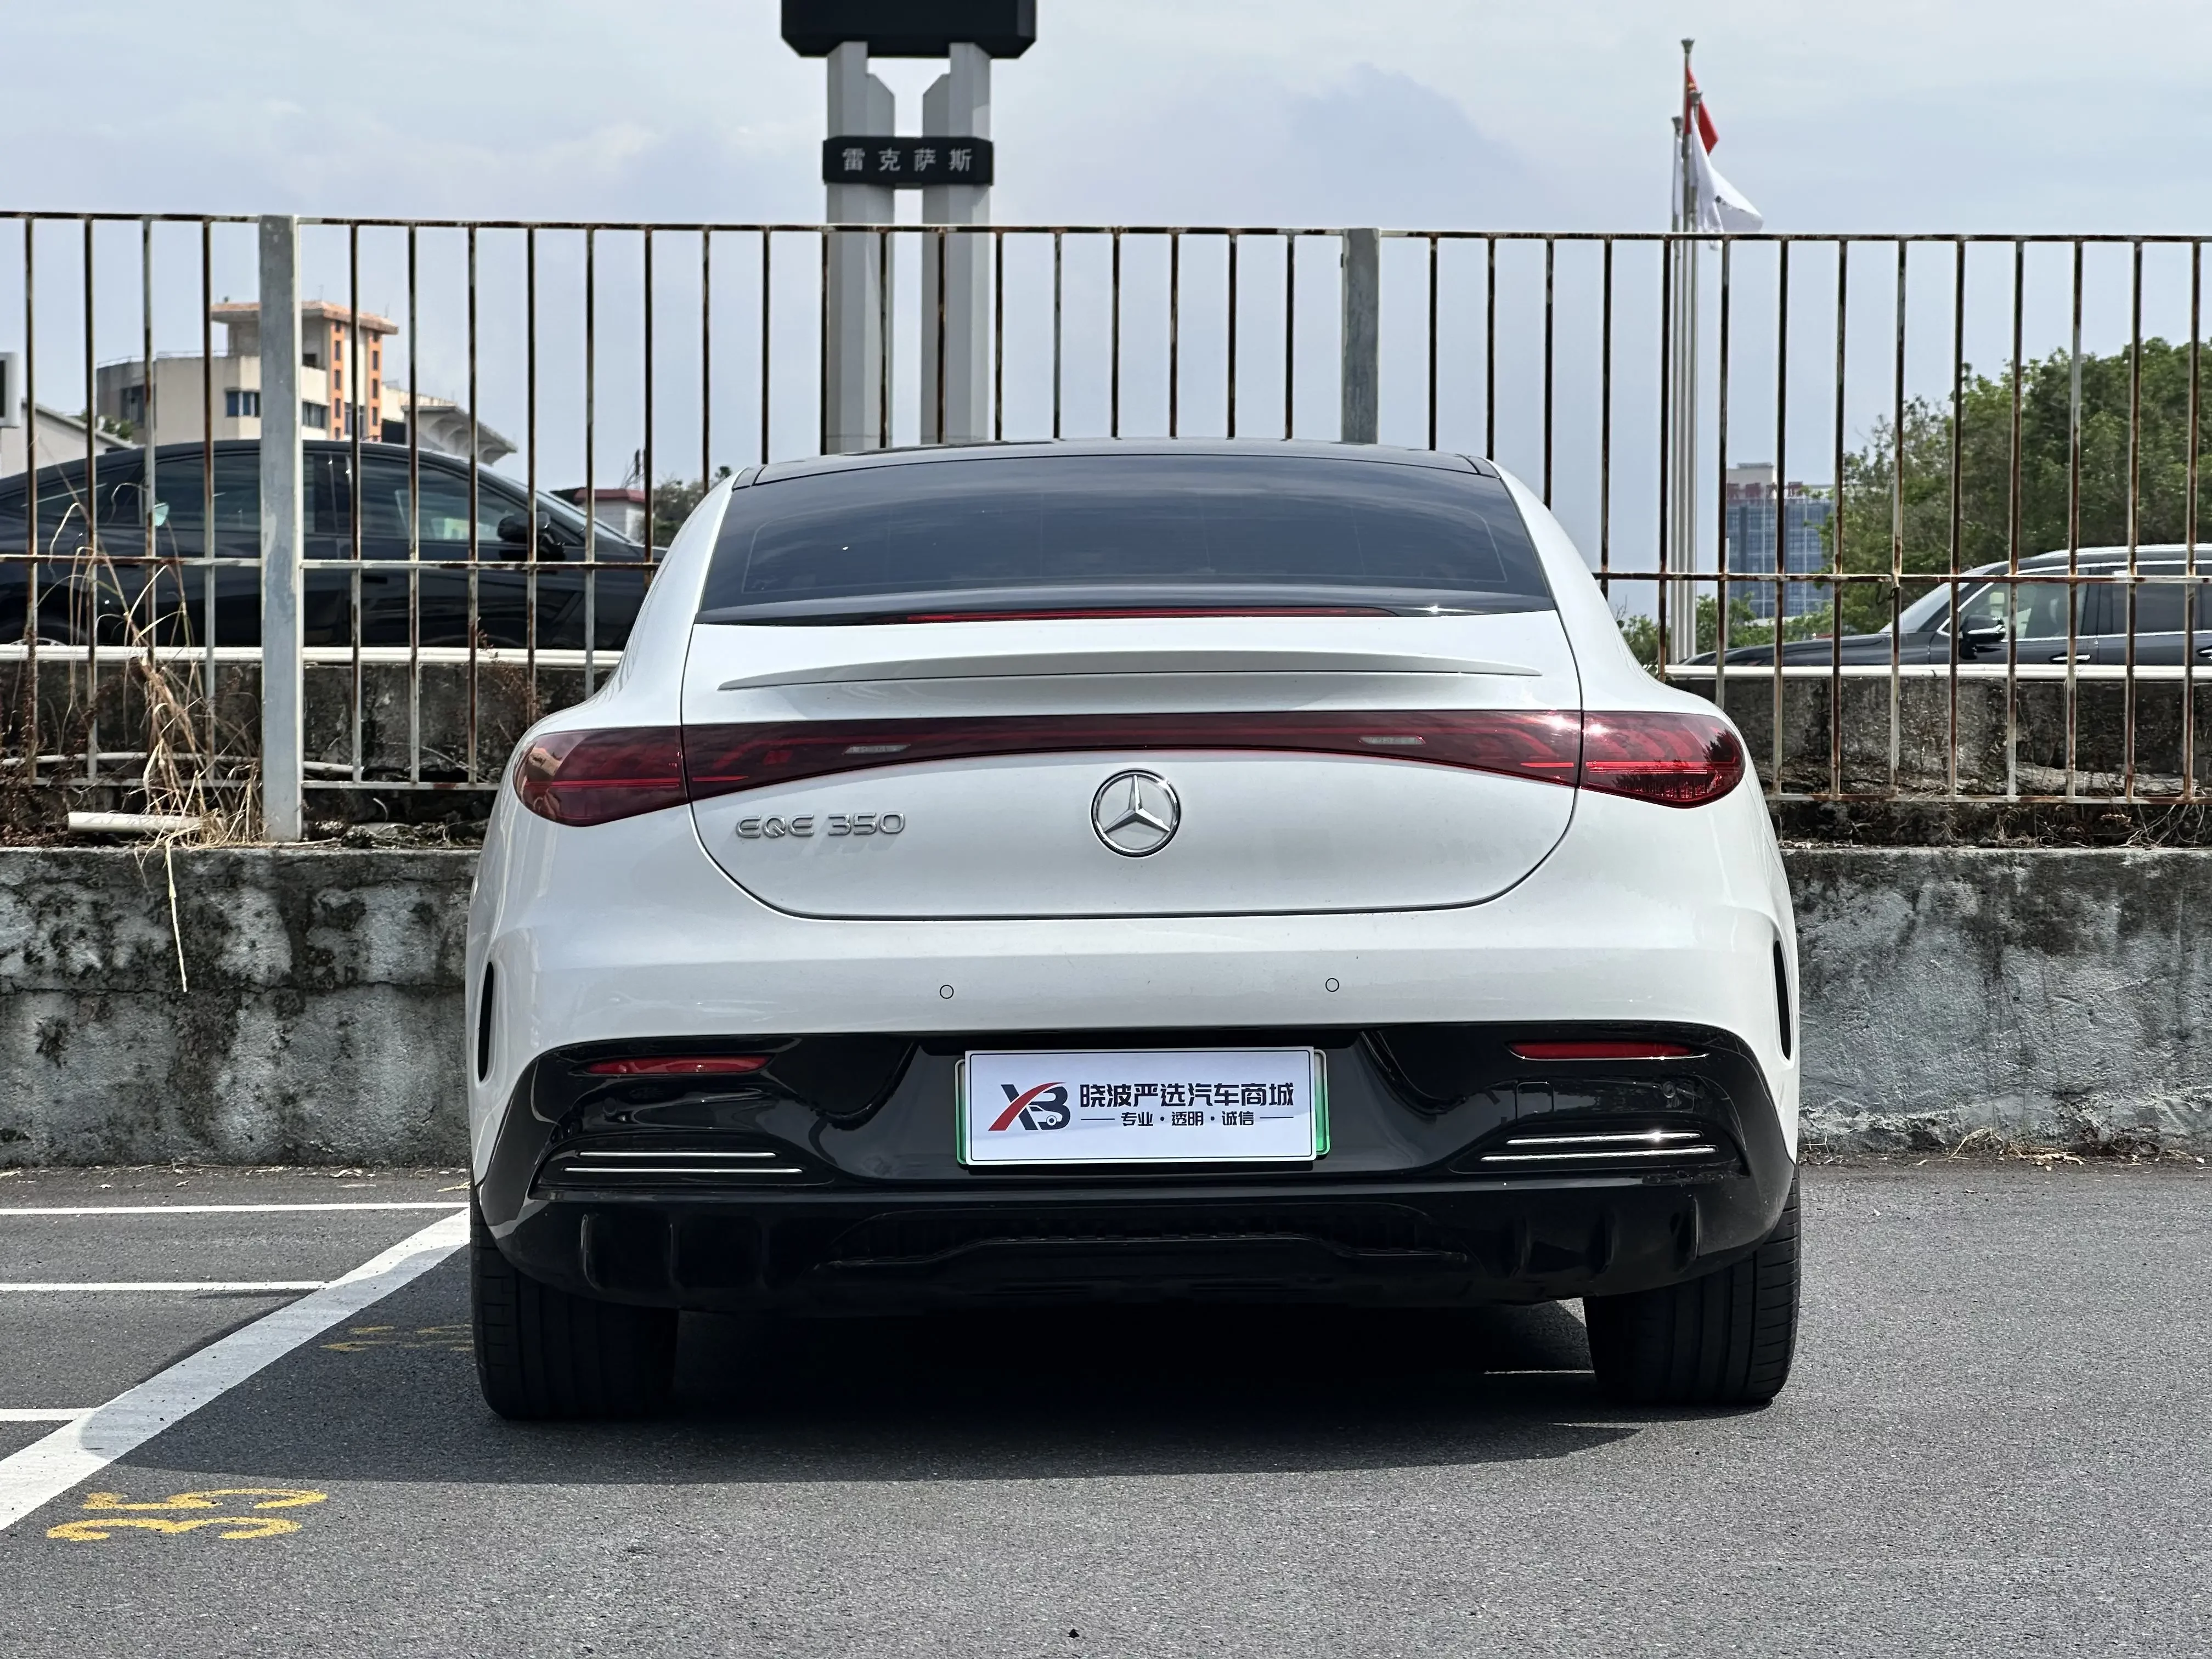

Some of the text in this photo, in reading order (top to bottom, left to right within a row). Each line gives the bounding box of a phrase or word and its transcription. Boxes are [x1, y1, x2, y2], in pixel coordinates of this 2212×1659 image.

[842, 147, 972, 172] 雷克萨斯
[736, 812, 905, 838] EQE 350
[1080, 1082, 1294, 1107] 晓波严选汽车商城
[46, 1488, 328, 1541] 35
